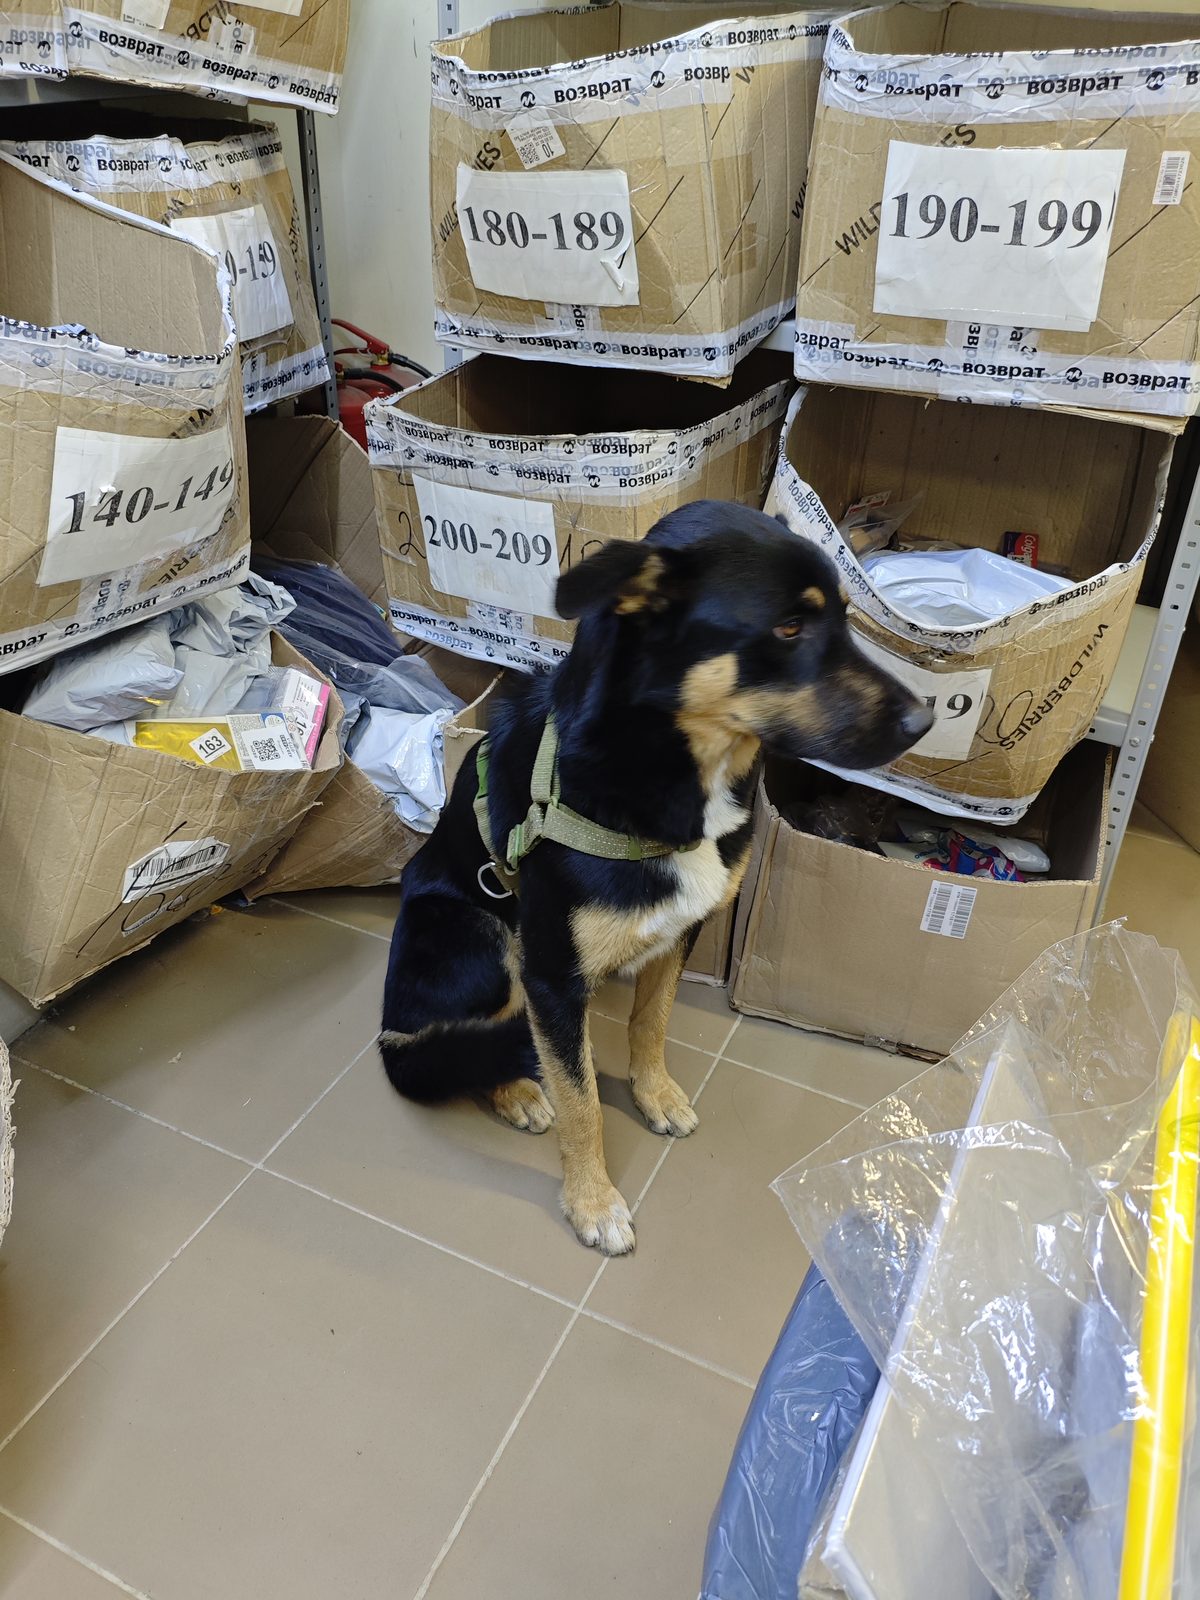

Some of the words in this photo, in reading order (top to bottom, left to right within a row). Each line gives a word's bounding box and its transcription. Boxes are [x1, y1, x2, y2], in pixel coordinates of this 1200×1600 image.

[99, 30, 165, 58] возврат
[201, 59, 257, 82] возврат
[288, 82, 338, 105] возврат
[554, 78, 632, 103] возврат
[1027, 75, 1123, 97] возврат
[97, 158, 149, 175] возврат
[463, 206, 625, 251] 180-189
[888, 192, 1102, 249] 190-199
[519, 337, 579, 352] возврат
[622, 345, 687, 360] возврат
[963, 361, 1045, 380] возврат
[1102, 371, 1190, 391] возврат
[405, 426, 449, 442] возврат
[489, 439, 546, 453] возврат
[592, 443, 651, 457] возврат
[516, 468, 571, 484] возврат
[619, 466, 674, 488] возврат
[62, 457, 234, 535] 140-149
[424, 514, 552, 566] 200-209
[390, 608, 437, 627] возврат
[469, 626, 518, 647] возврат
[998, 623, 1109, 751] WILDBERRIES
[198, 735, 223, 755] 163
